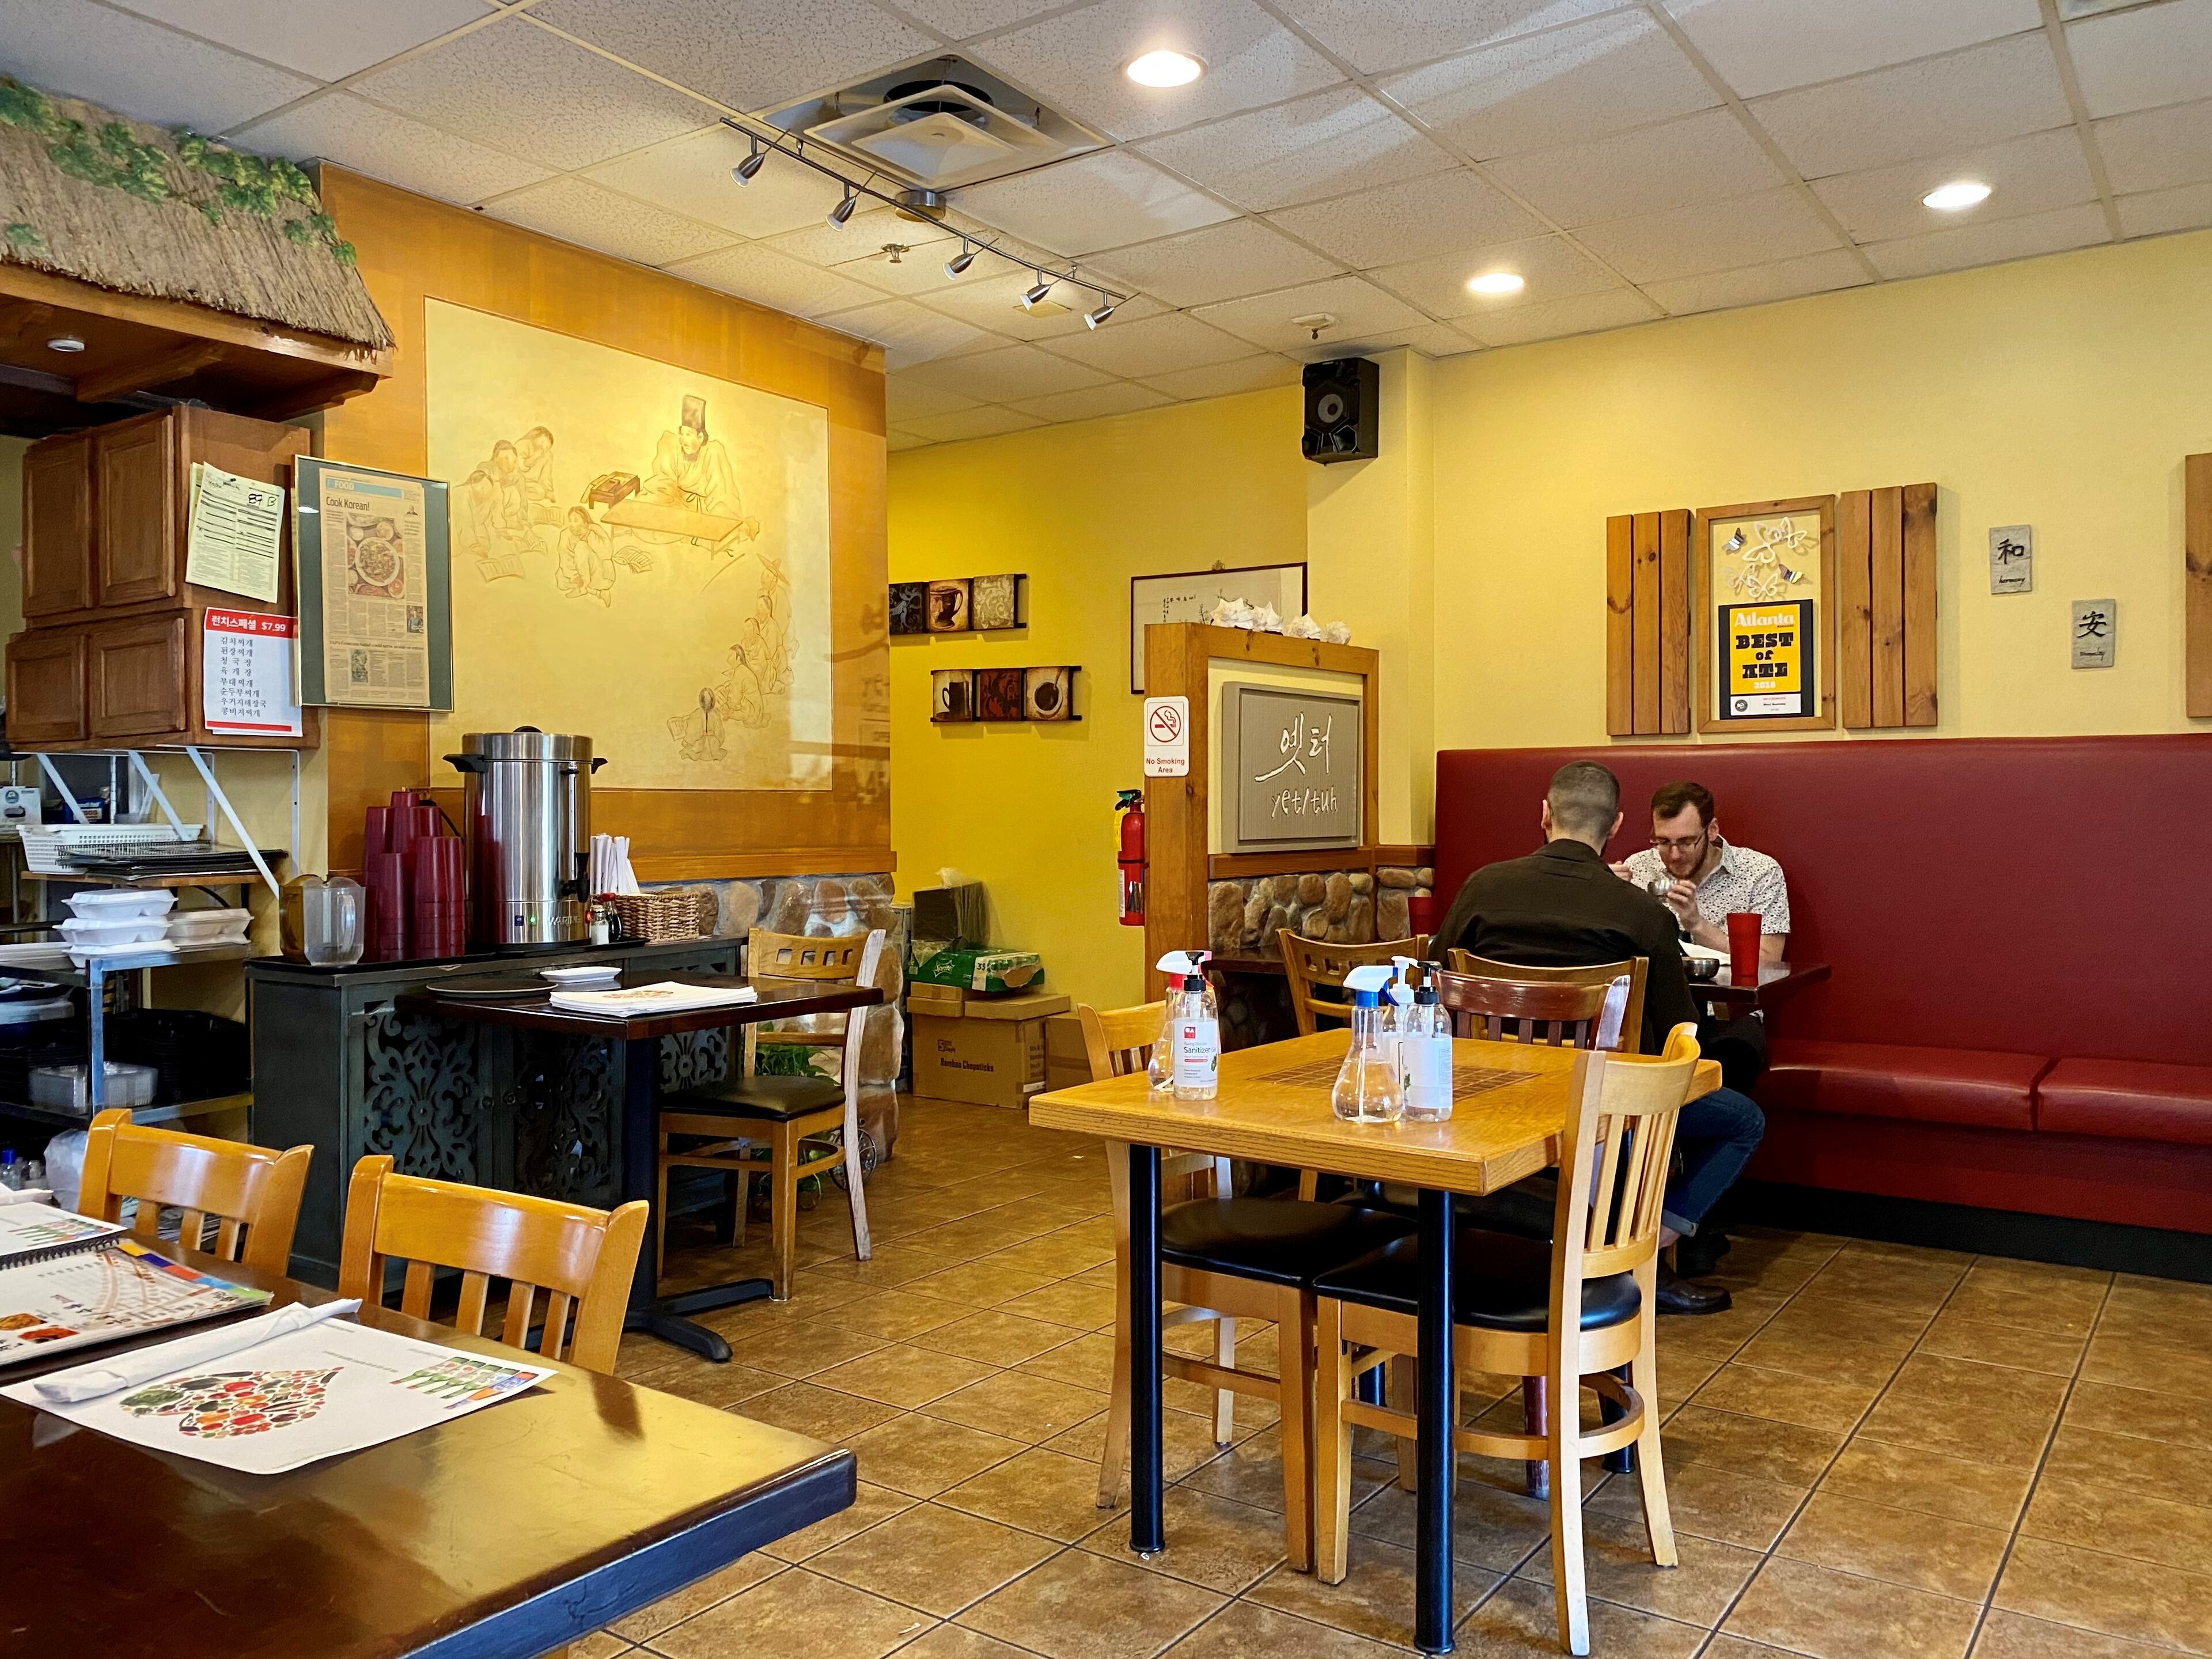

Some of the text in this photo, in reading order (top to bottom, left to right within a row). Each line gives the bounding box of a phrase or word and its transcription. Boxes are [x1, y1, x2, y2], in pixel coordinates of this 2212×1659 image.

[334, 480, 354, 490] FOOD
[267, 497, 276, 507] B
[326, 497, 370, 511] Cook Korean!
[1997, 538, 2024, 565] 和
[211, 615, 286, 632] 런치스페셜 $7.99
[1734, 612, 1795, 627] Atlanta
[2077, 611, 2107, 638] 安
[221, 637, 253, 647] 김치찌개
[1736, 632, 1794, 649] BEST
[221, 647, 253, 657] 된장찌개
[1755, 650, 1774, 661] of
[1742, 662, 1787, 679] ATL
[1157, 757, 1185, 766] Smoking
[1271, 785, 1338, 819] yet/tuh
[934, 964, 953, 972] Sprite
